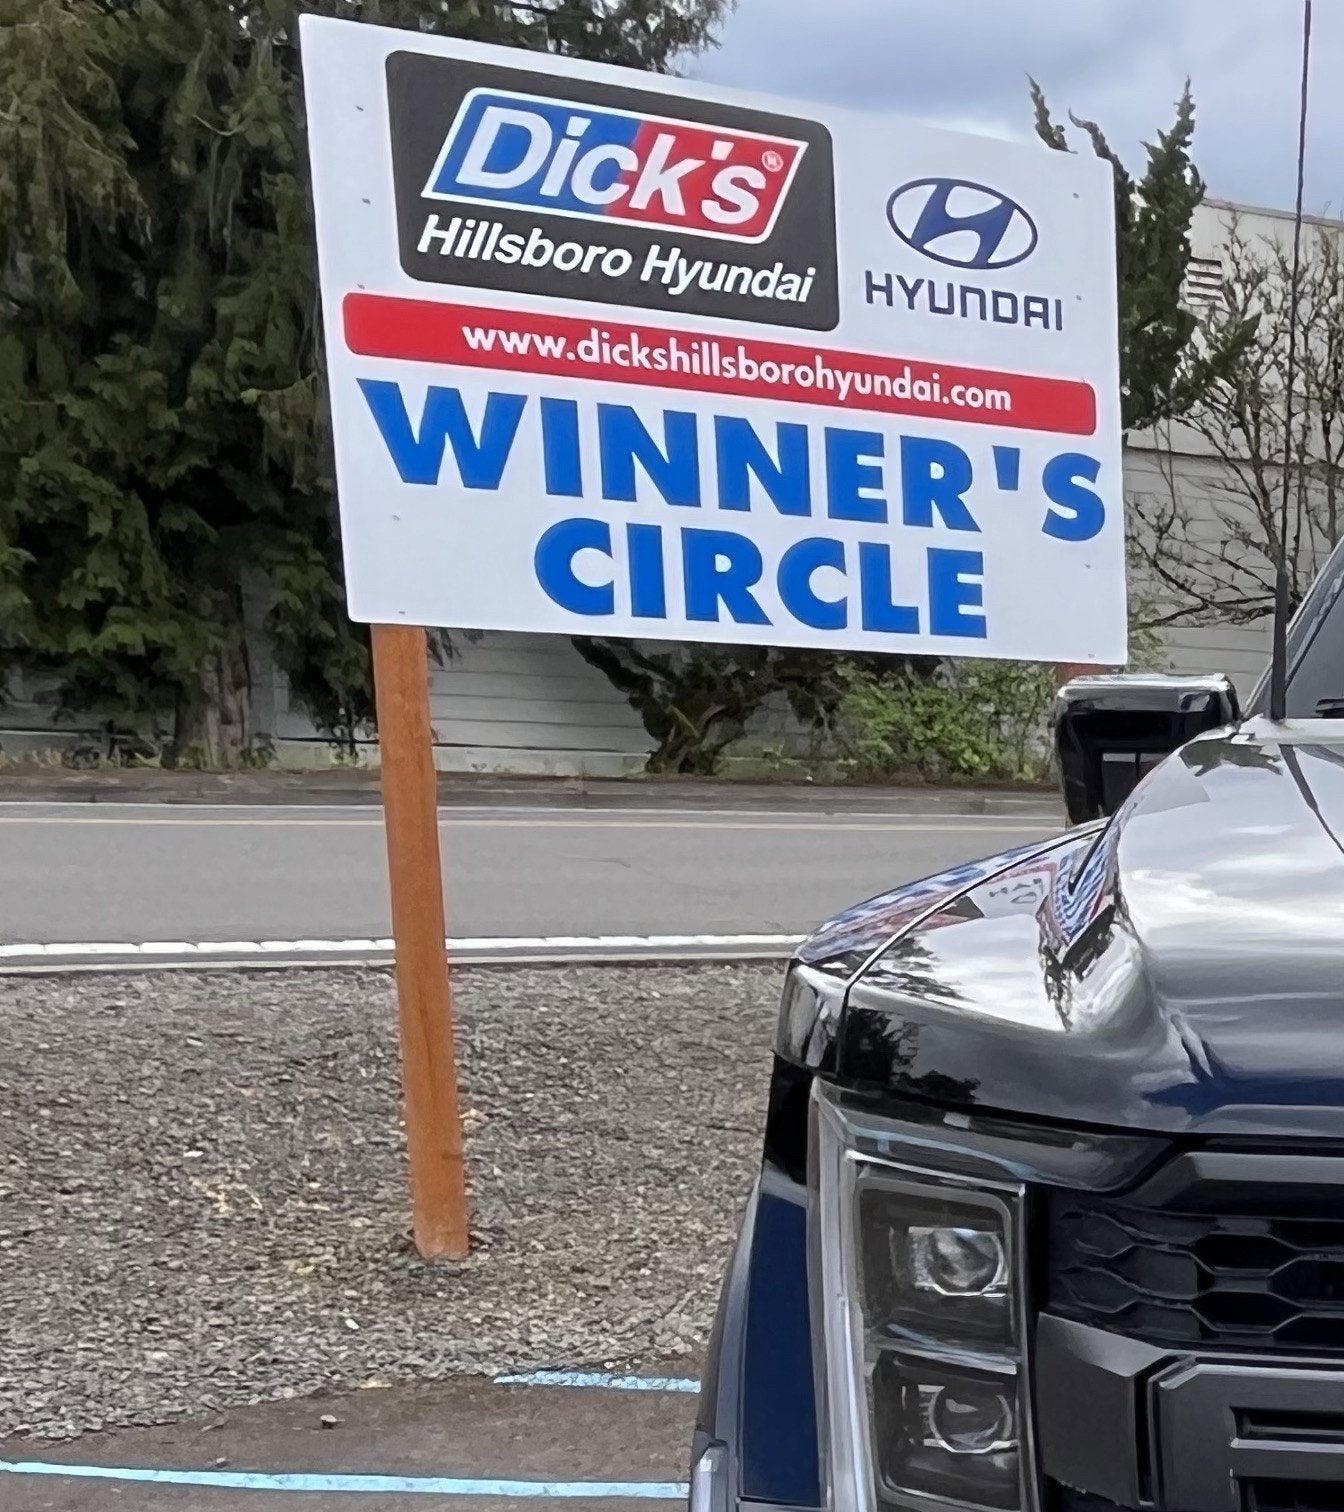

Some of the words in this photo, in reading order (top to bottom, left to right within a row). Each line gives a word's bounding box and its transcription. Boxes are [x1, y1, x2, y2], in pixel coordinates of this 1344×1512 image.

[456, 105, 764, 226] Dick's
[416, 213, 631, 277] Hillsboro
[641, 244, 816, 303] Hyundai
[864, 269, 1064, 332] HYUNDAI
[461, 324, 1012, 413] www.dickshillsborohyundai.com
[355, 376, 1106, 543] WINNER'S
[533, 516, 988, 639] CIRCLE
